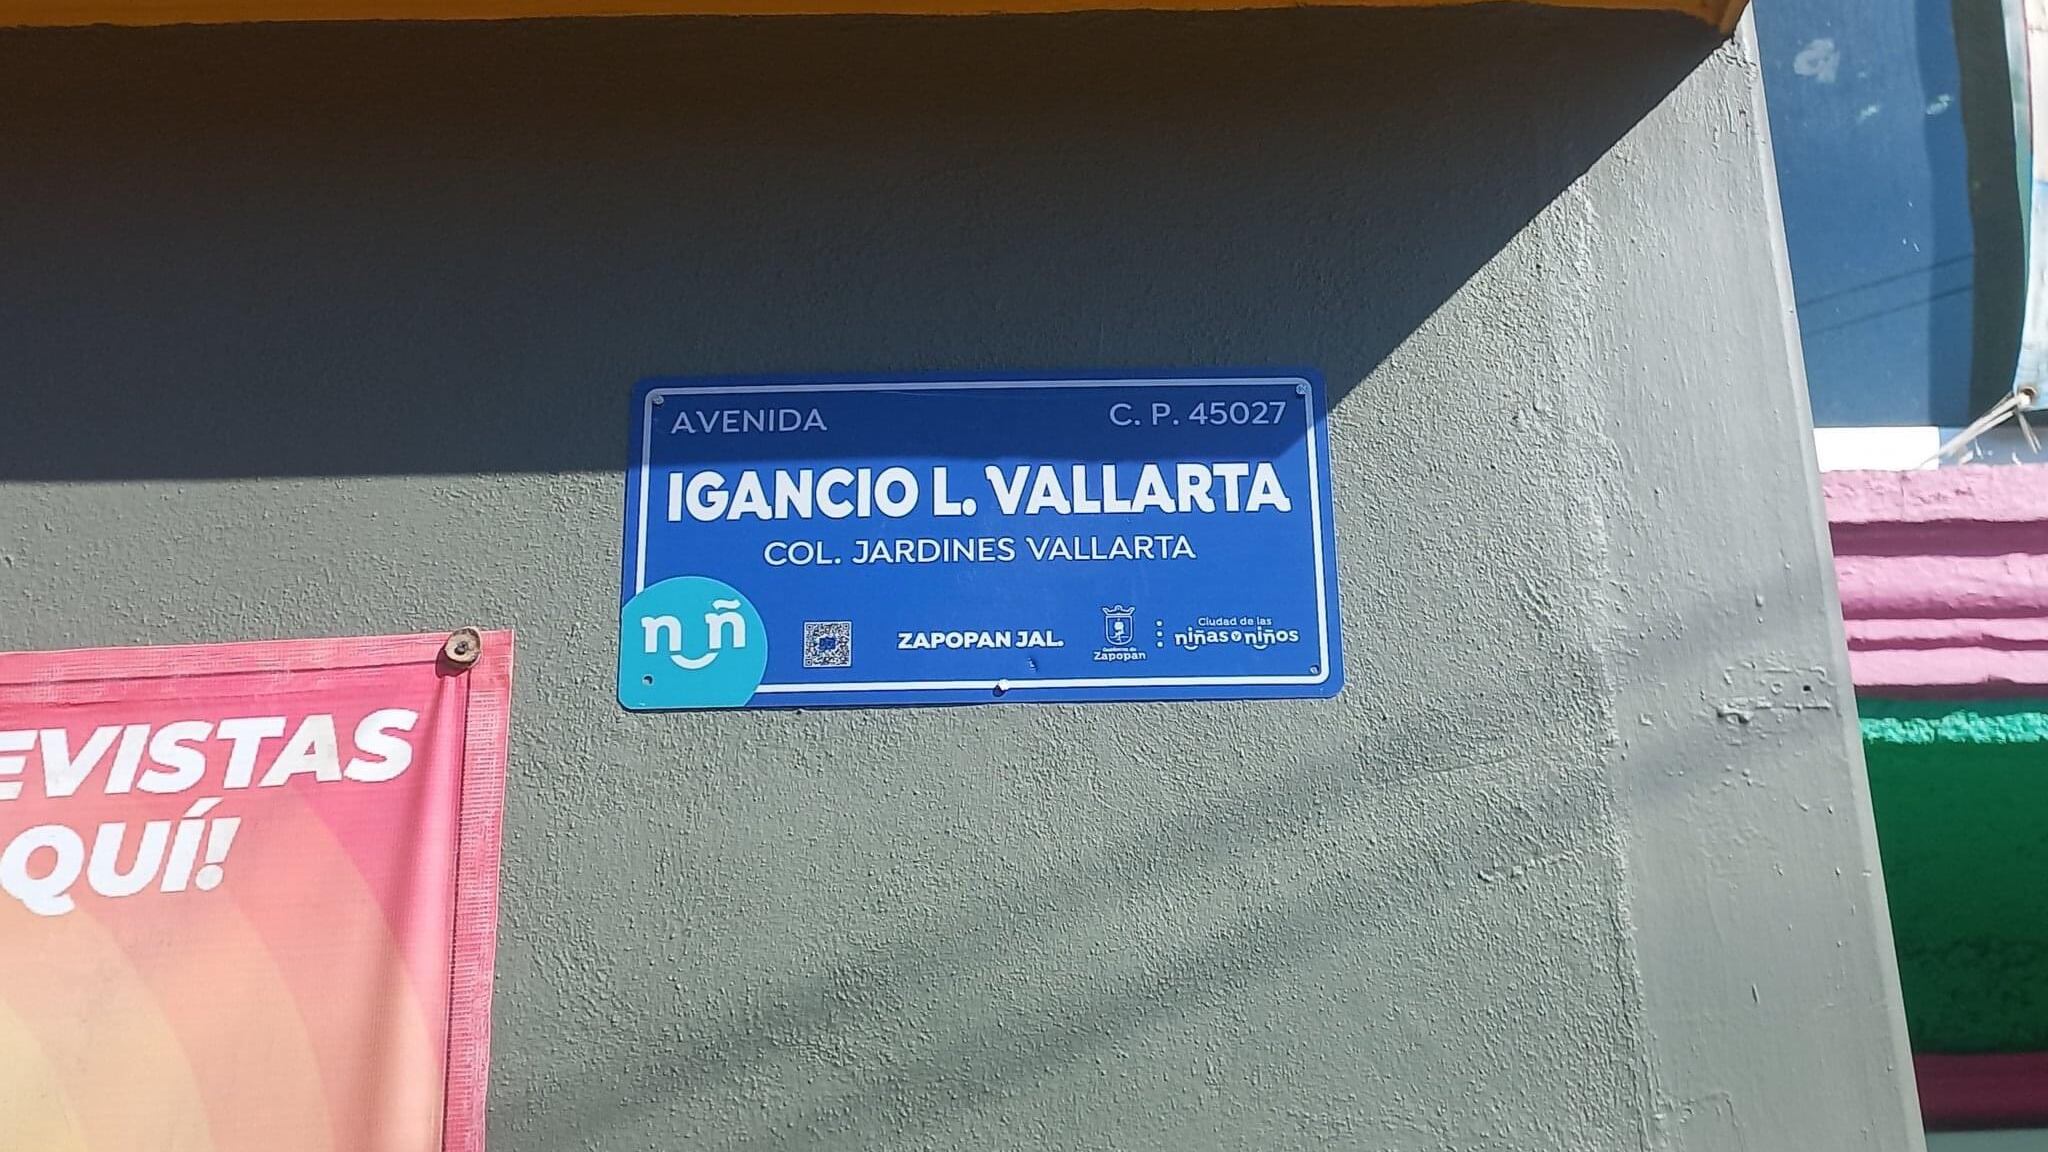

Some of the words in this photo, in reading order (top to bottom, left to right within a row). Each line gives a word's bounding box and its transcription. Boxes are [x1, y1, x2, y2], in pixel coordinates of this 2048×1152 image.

[671, 408, 827, 434] AVENIDA
[1109, 403, 1141, 426] C.
[1152, 403, 1179, 425] P.
[1188, 401, 1286, 425] 45027
[667, 467, 920, 522] IGANCIO
[933, 466, 977, 516] L.
[985, 462, 1292, 515] VALLARTA
[764, 541, 841, 566] COL.
[853, 538, 1015, 563] JARDINES
[1026, 535, 1196, 561] VALLARTA
[1198, 617, 1237, 627] Ciudad
[1240, 617, 1254, 626] de
[1256, 616, 1272, 626] las
[897, 632, 1012, 649] ZAPOPAN
[1016, 631, 1064, 648] JAL.
[1174, 627, 1228, 650] niñas
[1244, 626, 1299, 649] niños
[1093, 652, 1147, 662] Zapopan
